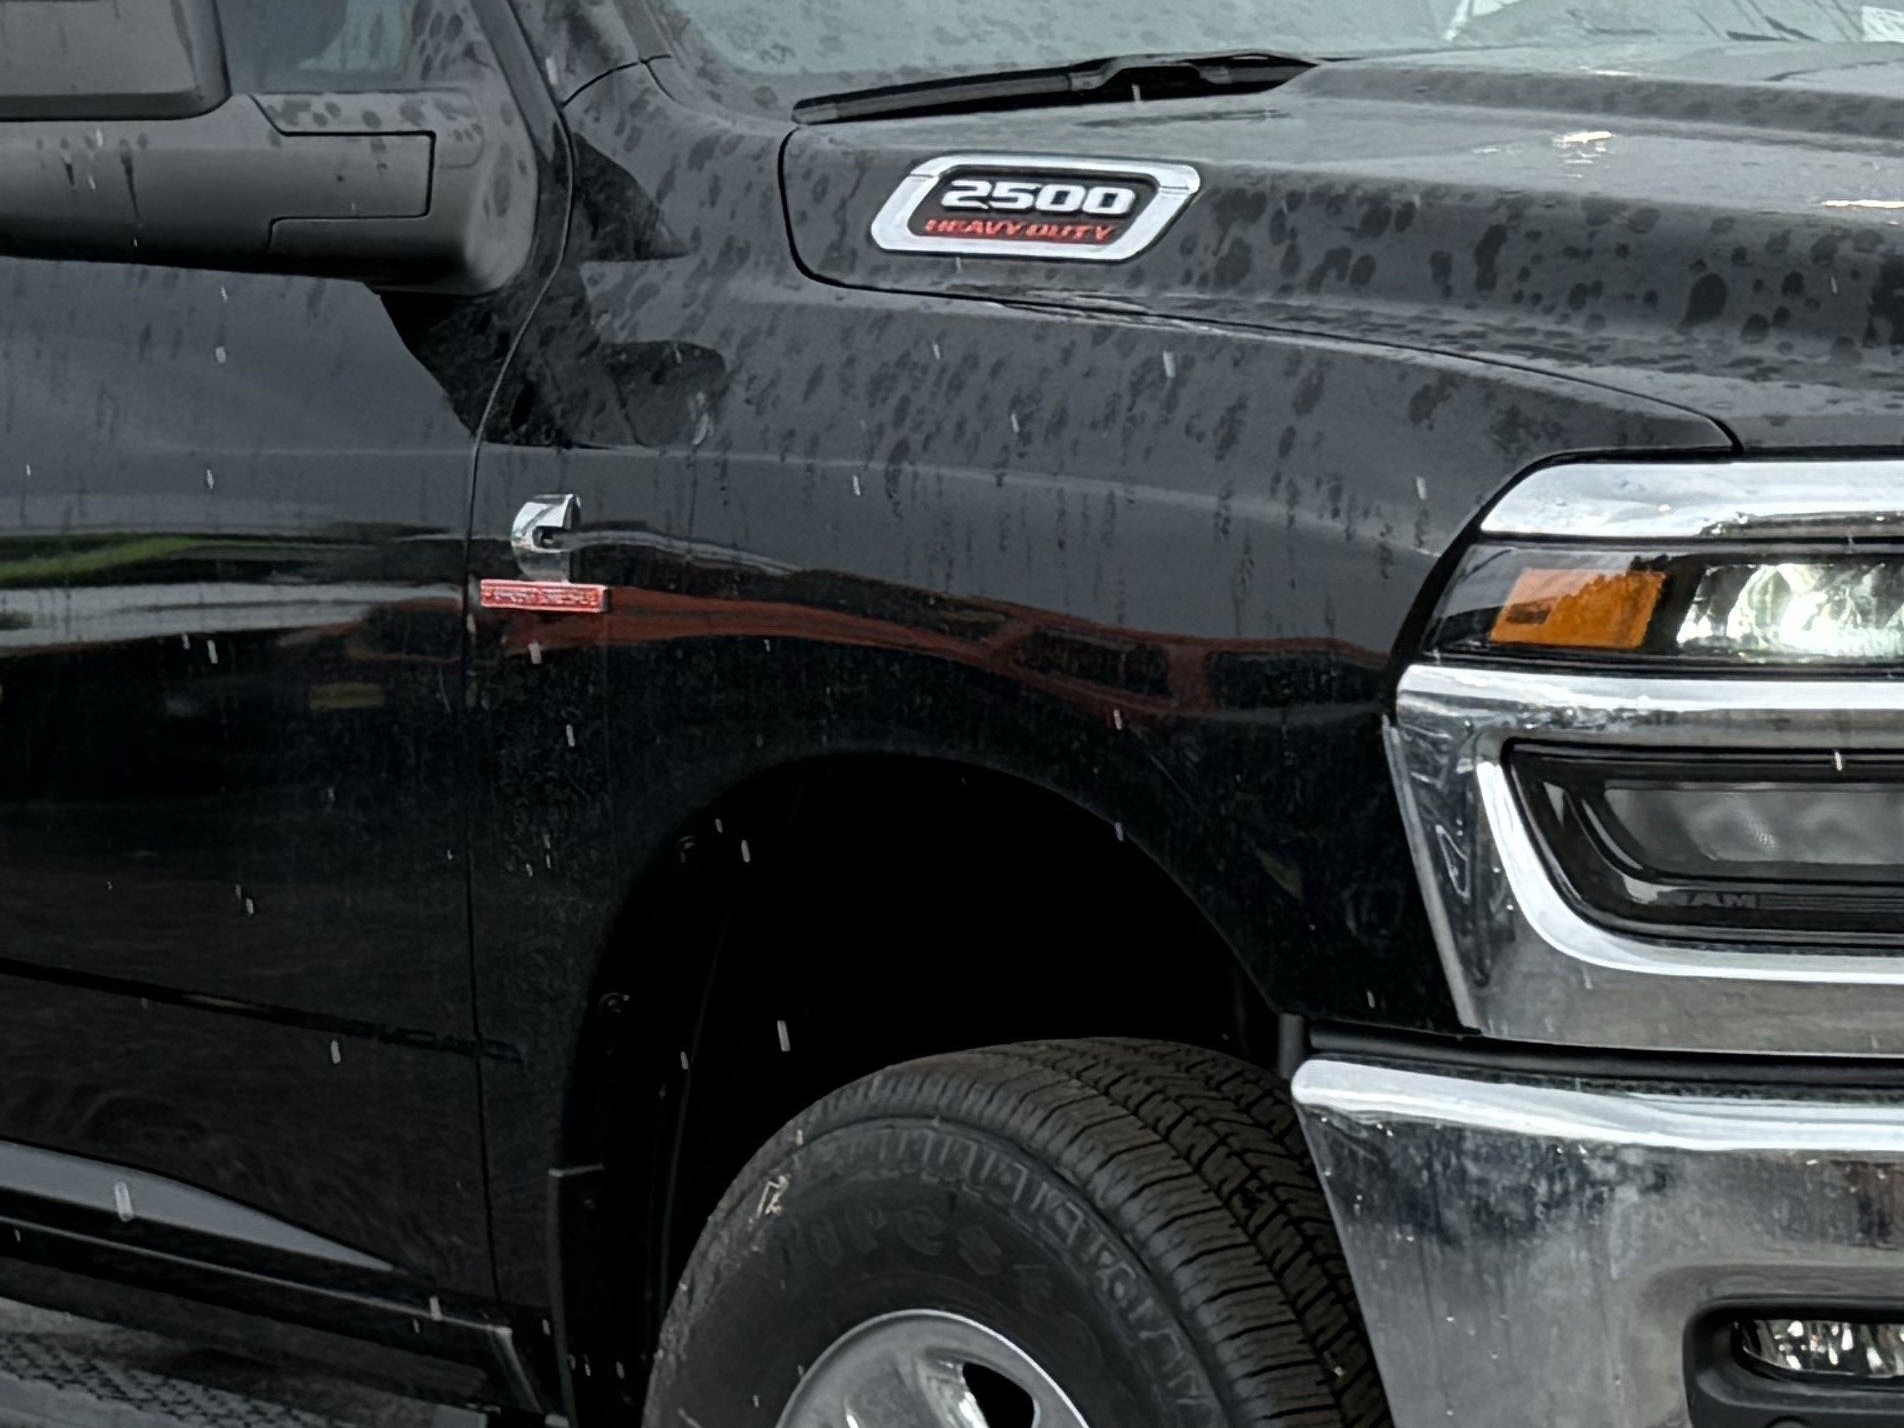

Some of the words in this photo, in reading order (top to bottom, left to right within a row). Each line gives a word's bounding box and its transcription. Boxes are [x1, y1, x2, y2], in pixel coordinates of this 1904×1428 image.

[941, 180, 1136, 215] 2500
[925, 219, 1023, 237] HEAVY
[1025, 223, 1117, 241] DUTY
